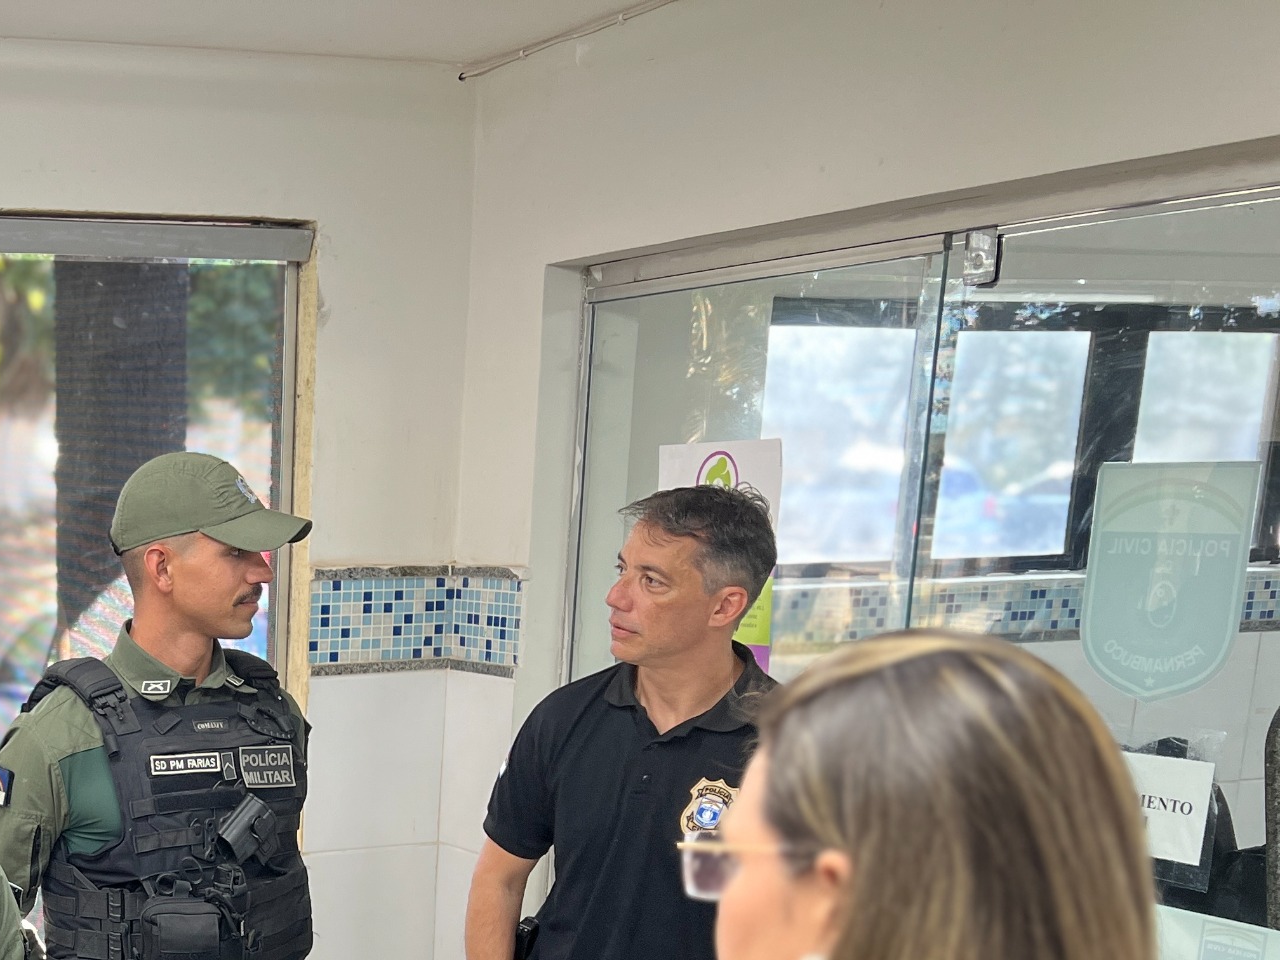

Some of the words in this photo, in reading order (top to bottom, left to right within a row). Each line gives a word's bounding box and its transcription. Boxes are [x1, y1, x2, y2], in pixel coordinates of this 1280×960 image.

[155, 761, 166, 770] SD
[170, 760, 184, 770] PM
[187, 758, 216, 769] FARIAS
[242, 751, 290, 767] POLÍCIA
[245, 770, 291, 784] MILITAR
